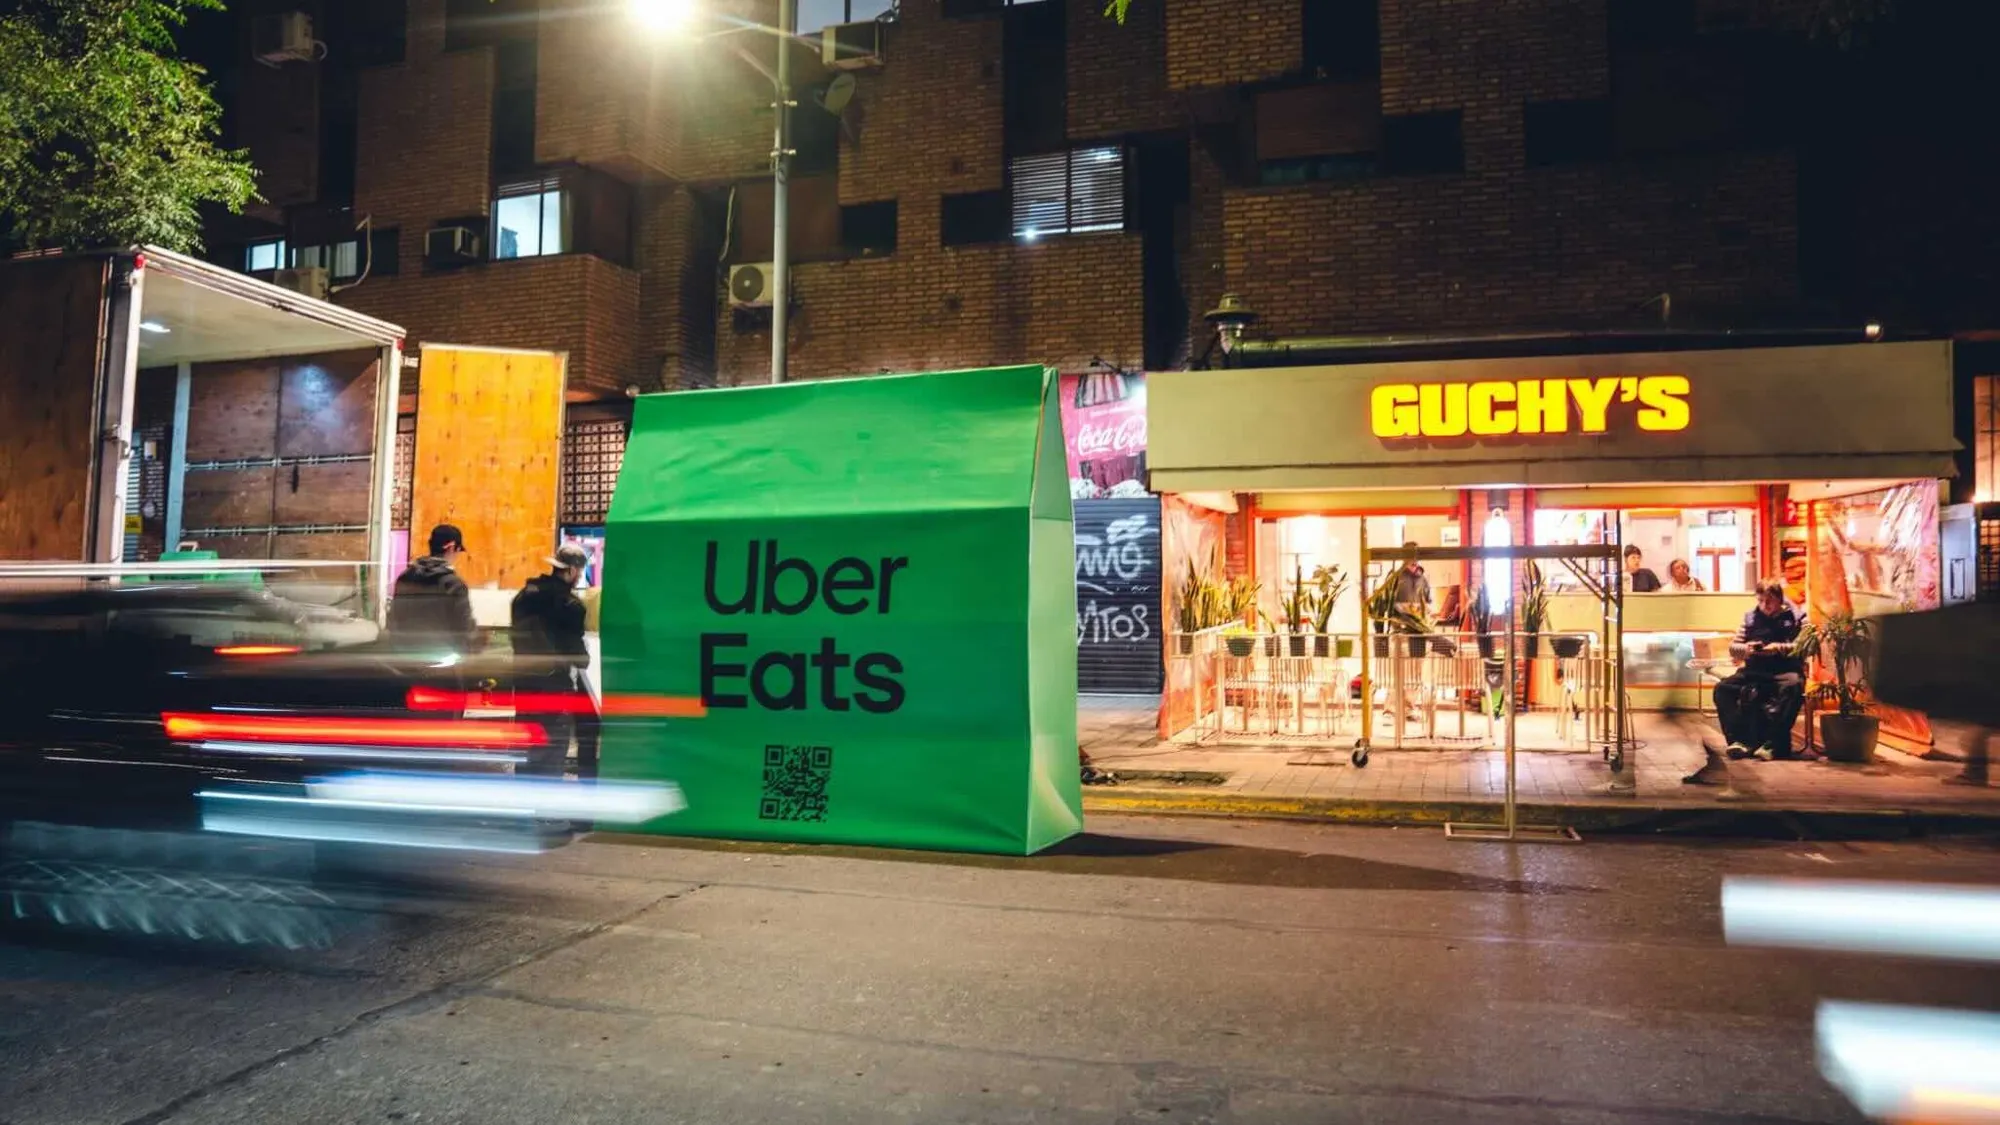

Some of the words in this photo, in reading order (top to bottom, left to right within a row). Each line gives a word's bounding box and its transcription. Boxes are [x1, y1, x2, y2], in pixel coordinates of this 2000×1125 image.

[1371, 376, 1690, 438] GUCHY'S
[704, 539, 909, 616] Uber
[699, 633, 906, 714] Eats
